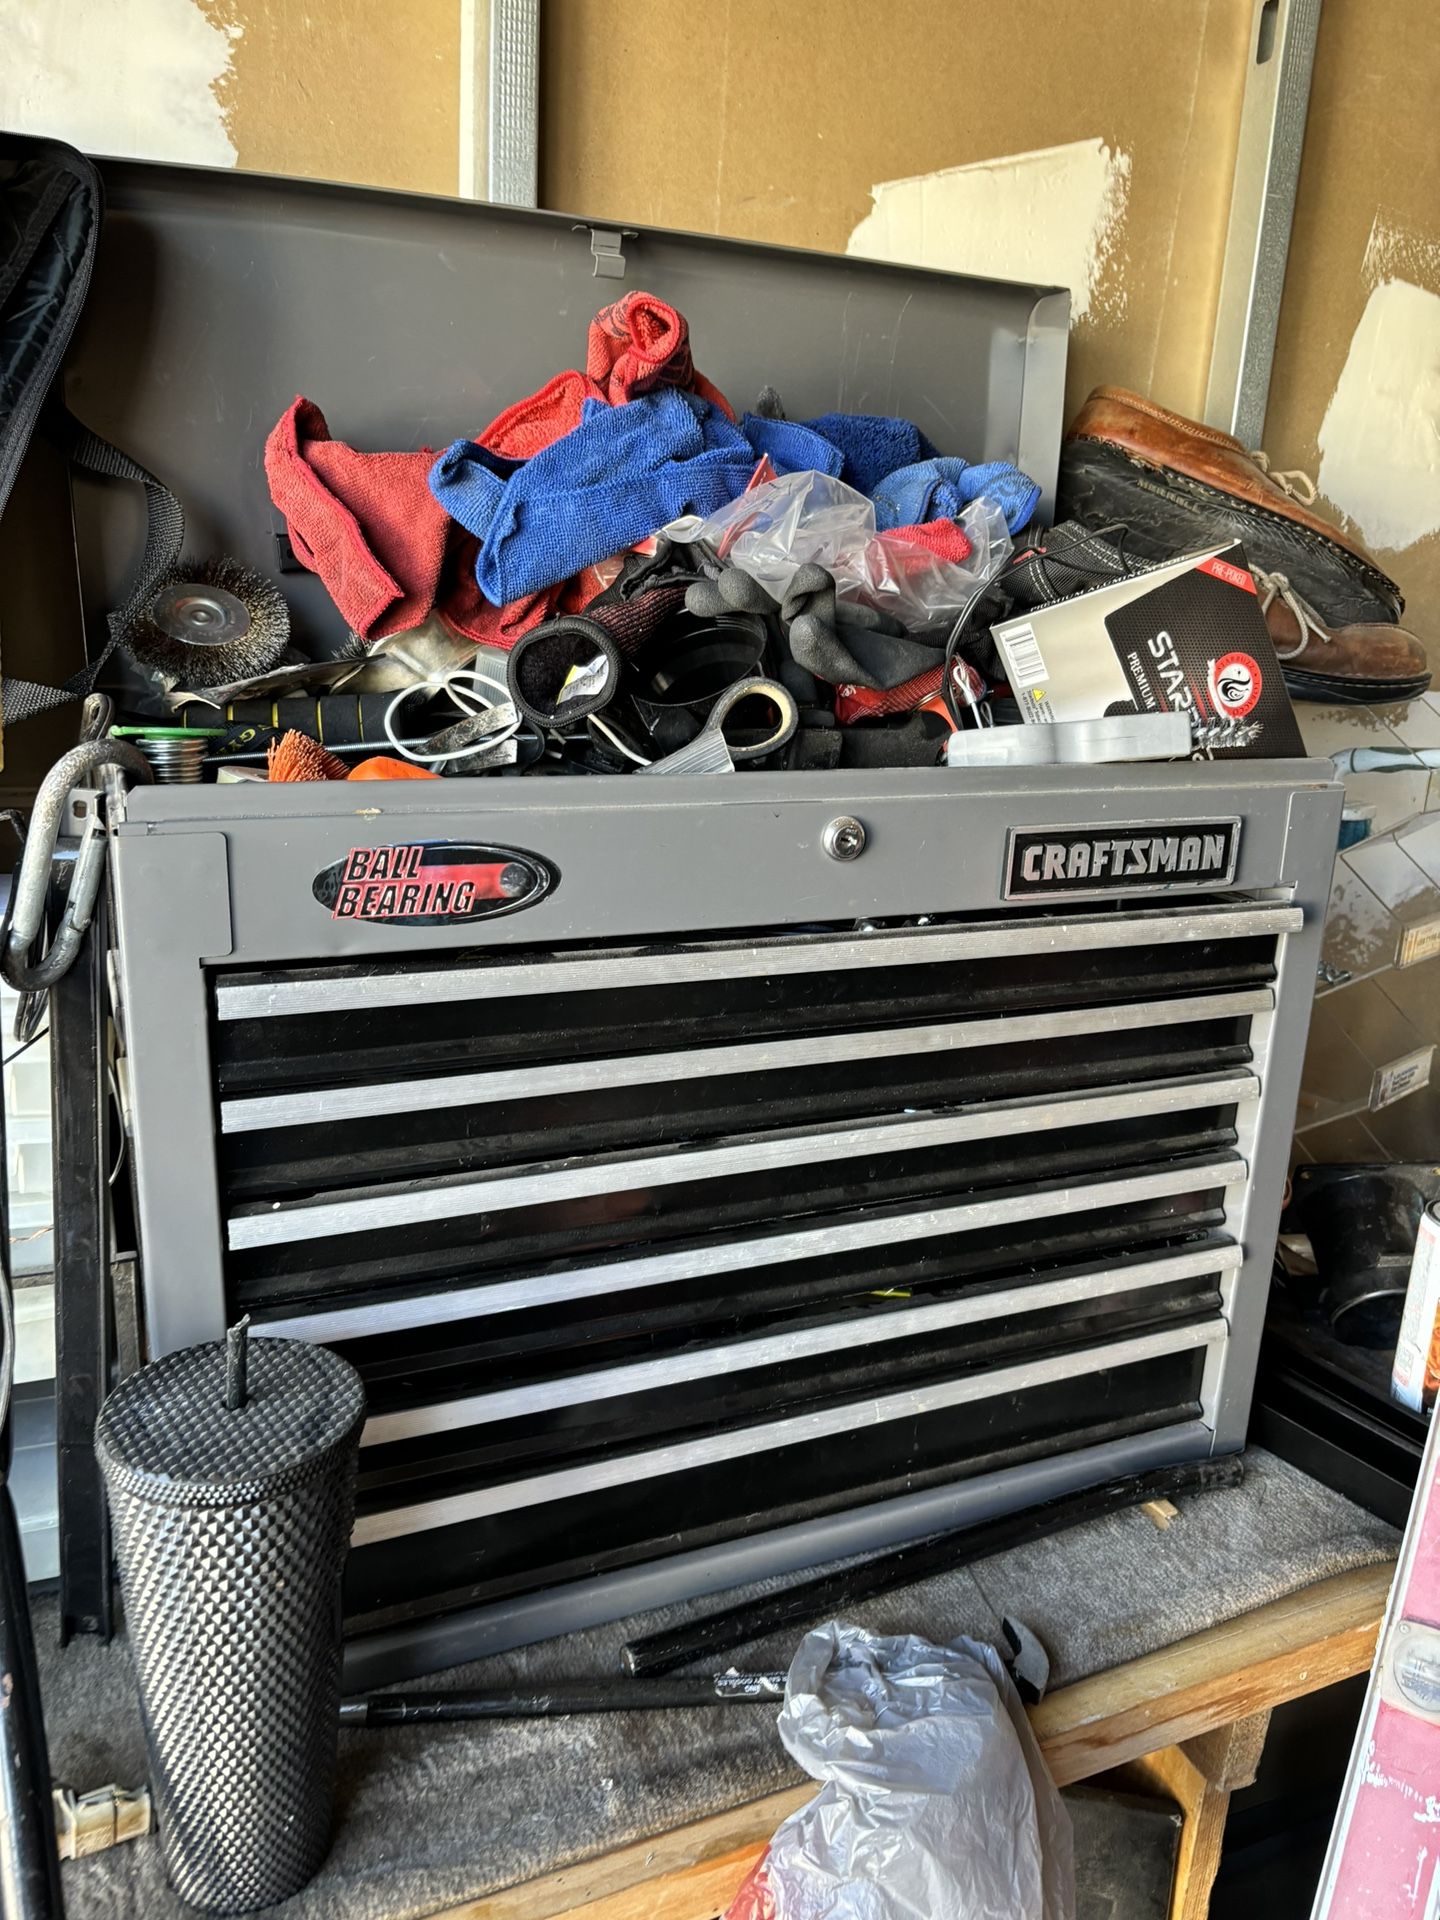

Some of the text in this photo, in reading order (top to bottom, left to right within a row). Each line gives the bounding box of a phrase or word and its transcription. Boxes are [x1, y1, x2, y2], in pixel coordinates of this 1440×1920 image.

[1127, 651, 1155, 709] PREMIUM
[344, 846, 424, 882] BALL
[1021, 834, 1226, 882] CRAFTSMAN
[332, 880, 476, 919] BEARING
